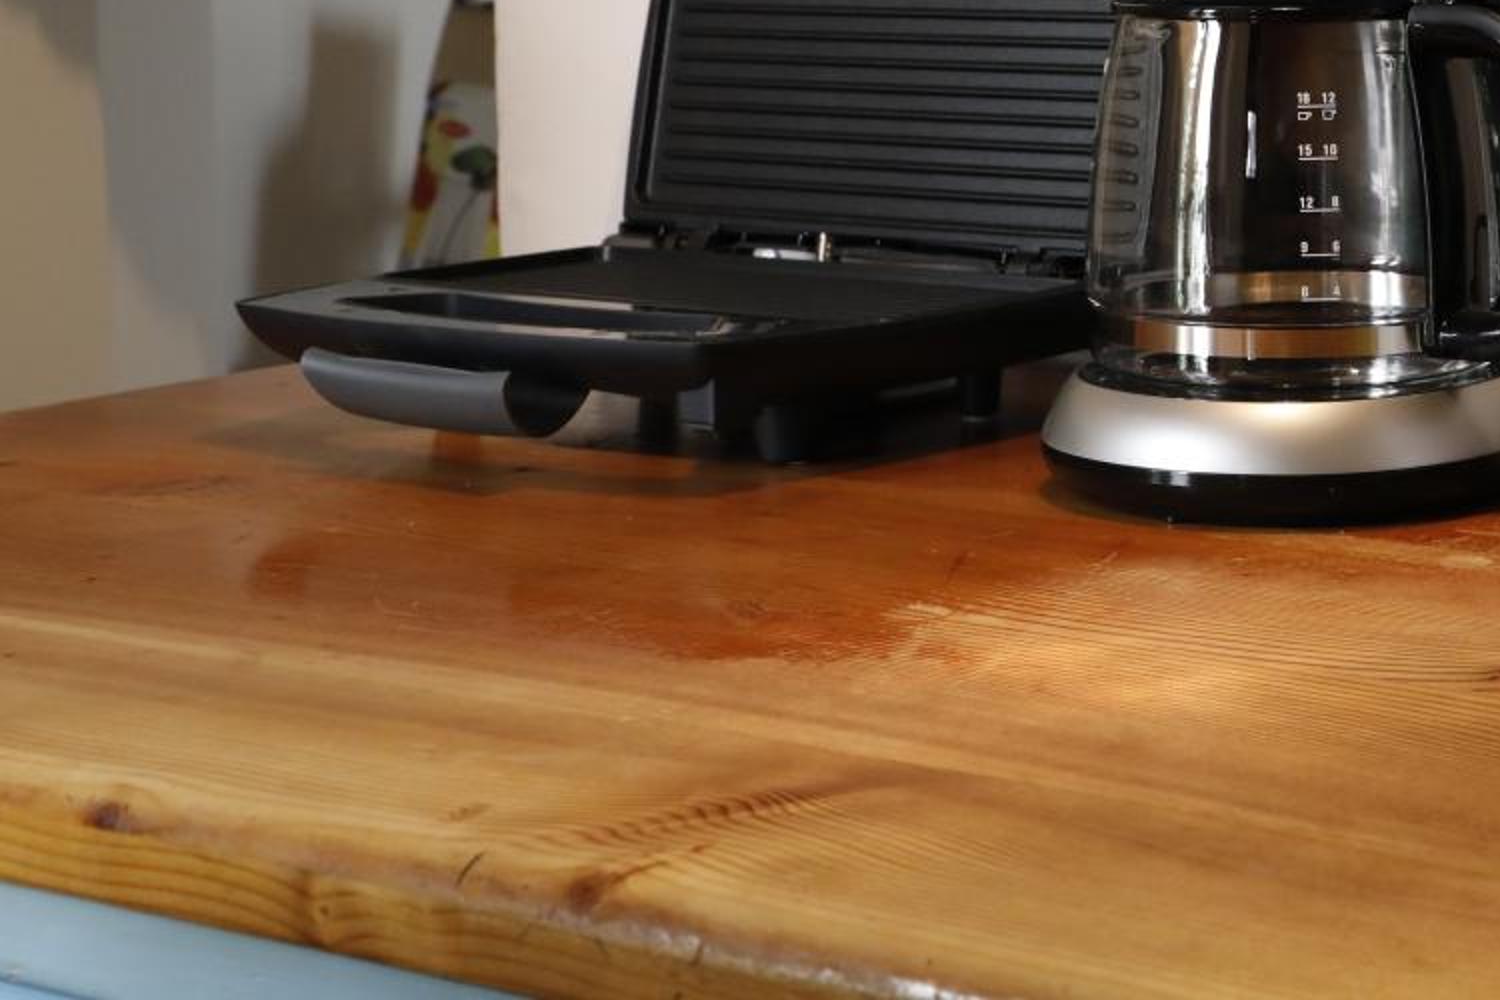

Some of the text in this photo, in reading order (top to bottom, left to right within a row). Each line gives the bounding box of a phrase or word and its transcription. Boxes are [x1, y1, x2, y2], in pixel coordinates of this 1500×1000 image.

[1321, 91, 1336, 103] 12
[1298, 144, 1338, 156] 15 10
[1299, 197, 1313, 208] 12
